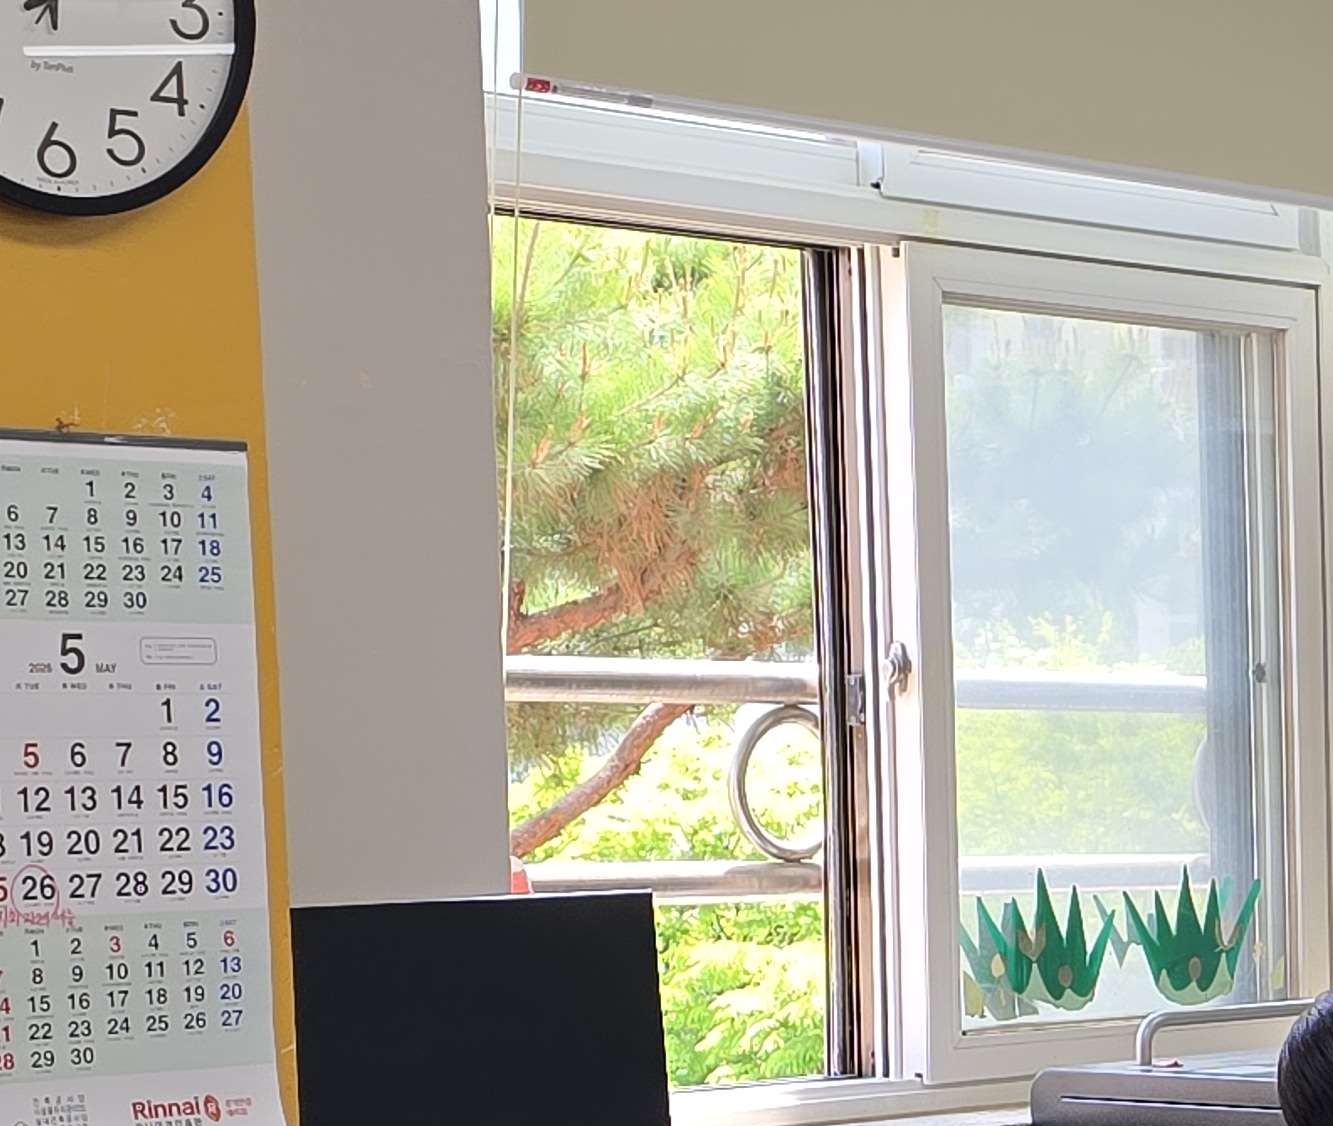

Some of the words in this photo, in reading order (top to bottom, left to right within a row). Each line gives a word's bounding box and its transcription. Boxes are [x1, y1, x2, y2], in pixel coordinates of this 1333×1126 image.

[169, 0, 209, 40] 3
[150, 60, 188, 117] 4
[37, 121, 77, 178] 6
[106, 108, 146, 167] 5
[85, 480, 95, 497] 1
[124, 482, 136, 499] 2
[163, 484, 174, 500] 3
[201, 485, 212, 501] 4
[7, 505, 19, 522] 6
[46, 507, 58, 523] 7
[87, 508, 98, 525] 8
[125, 509, 137, 526] 9
[158, 511, 181, 528] 10
[198, 513, 218, 529] 11
[2, 533, 26, 551] 13
[43, 534, 66, 552] 14
[83, 535, 105, 553] 15
[121, 537, 144, 554] 16
[161, 538, 182, 555] 17
[198, 539, 221, 556] 18
[4, 561, 28, 578] 20
[44, 562, 65, 579] 21
[83, 563, 107, 580] 22
[122, 564, 145, 581] 23
[160, 565, 183, 582] 24
[199, 566, 222, 583] 25
[5, 589, 29, 606] 27
[45, 590, 69, 607] 28
[84, 591, 108, 608] 29
[123, 592, 147, 609] 30
[60, 633, 85, 675] 5
[96, 663, 117, 673] MAY
[161, 698, 172, 723] 1
[205, 698, 221, 723] 2
[23, 743, 39, 768] 5
[70, 742, 86, 767] 6
[115, 742, 132, 767] 7
[163, 741, 178, 766] 8
[206, 741, 223, 765] 9
[17, 787, 51, 812] 12
[64, 786, 97, 811] 13
[111, 785, 144, 809] 14
[157, 784, 188, 809] 15
[202, 783, 233, 808] 16
[20, 831, 53, 856] 19
[66, 829, 100, 855] 20
[113, 828, 142, 853] 21
[158, 827, 191, 851] 22
[203, 826, 235, 850] 23
[21, 875, 55, 900] 26
[69, 873, 102, 898] 27
[116, 872, 148, 897] 28
[161, 870, 193, 895] 29
[205, 868, 237, 893] 30
[30, 939, 39, 957] 1
[70, 938, 82, 955] 2
[109, 936, 121, 953] 3
[148, 934, 159, 950] 4
[186, 932, 198, 949] 5
[223, 930, 235, 947] 6
[32, 967, 43, 985] 8
[72, 965, 83, 982] 9
[105, 963, 128, 980] 10
[144, 961, 165, 978] 11
[182, 959, 205, 976] 12
[220, 957, 242, 974] 13
[27, 995, 51, 1013] 15
[67, 993, 90, 1010] 16
[107, 991, 129, 1008] 17
[145, 988, 168, 1005] 18
[183, 986, 205, 1003] 19
[220, 983, 243, 1000] 20
[28, 1023, 53, 1041] 22
[68, 1020, 92, 1039] 23
[107, 1017, 130, 1035] 24
[146, 1015, 169, 1032] 25
[183, 1012, 206, 1029] 26
[221, 1009, 243, 1027] 27
[30, 1050, 55, 1068] 29
[70, 1047, 94, 1065] 30
[132, 1096, 202, 1121] Rinnai
